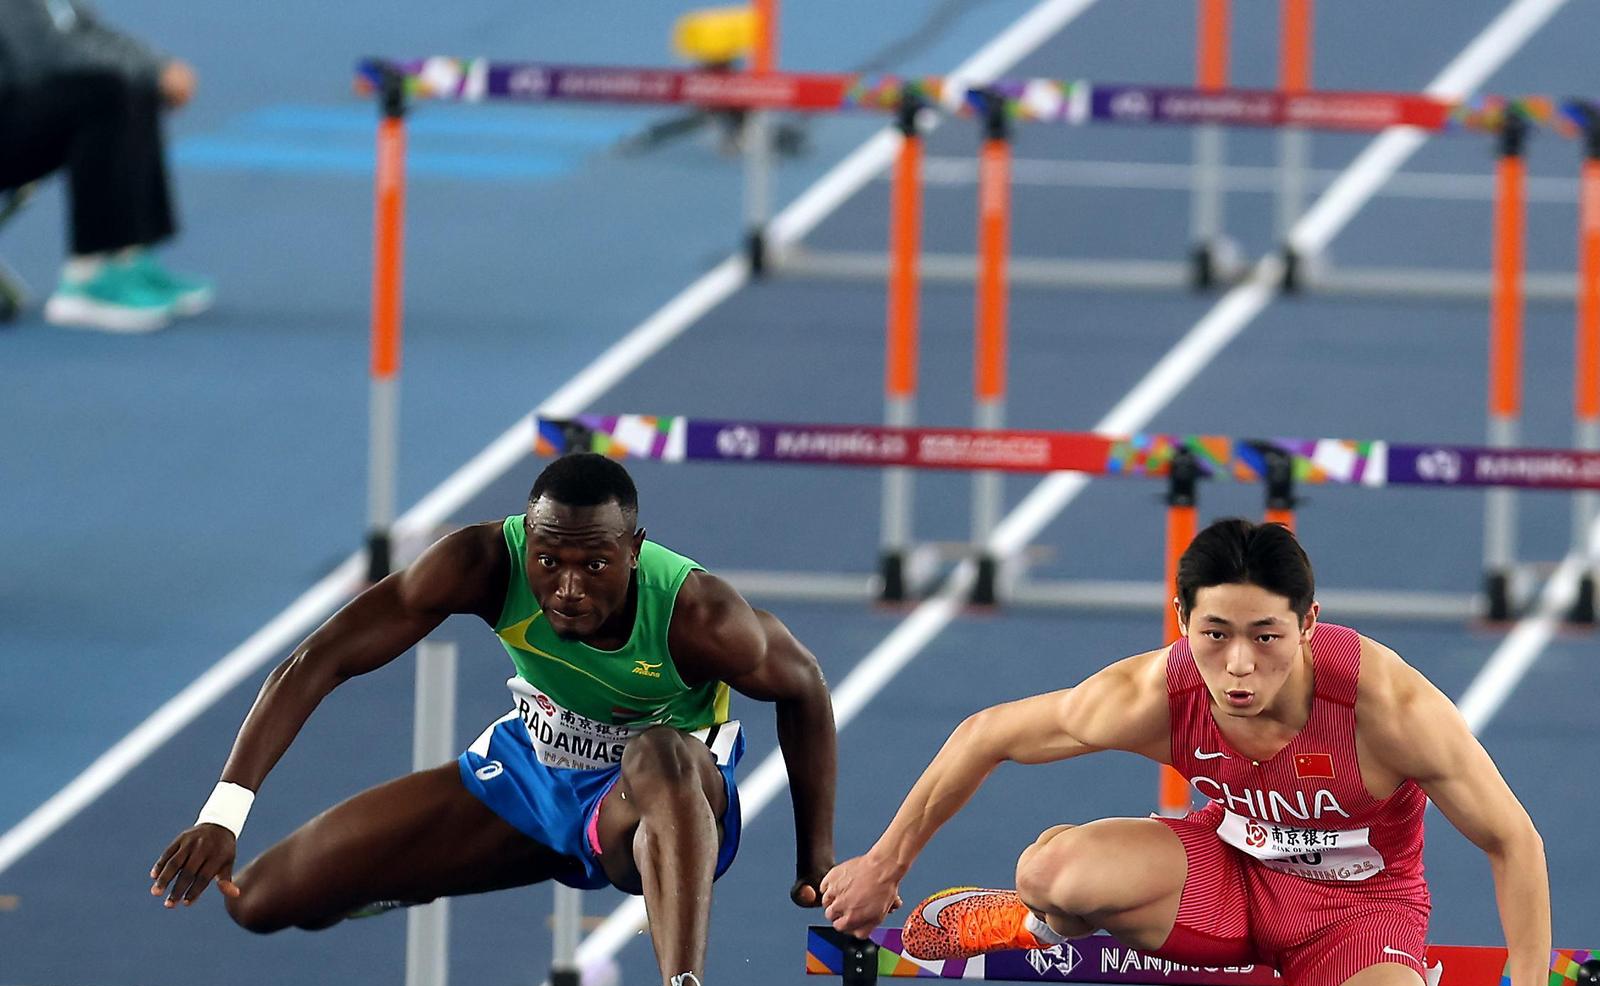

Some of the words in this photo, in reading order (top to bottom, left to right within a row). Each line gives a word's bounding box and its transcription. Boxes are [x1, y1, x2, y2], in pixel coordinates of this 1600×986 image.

[560, 708, 629, 736] 南京银行
[1190, 776, 1350, 823] CHINA
[1271, 825, 1339, 847] 南京银行
